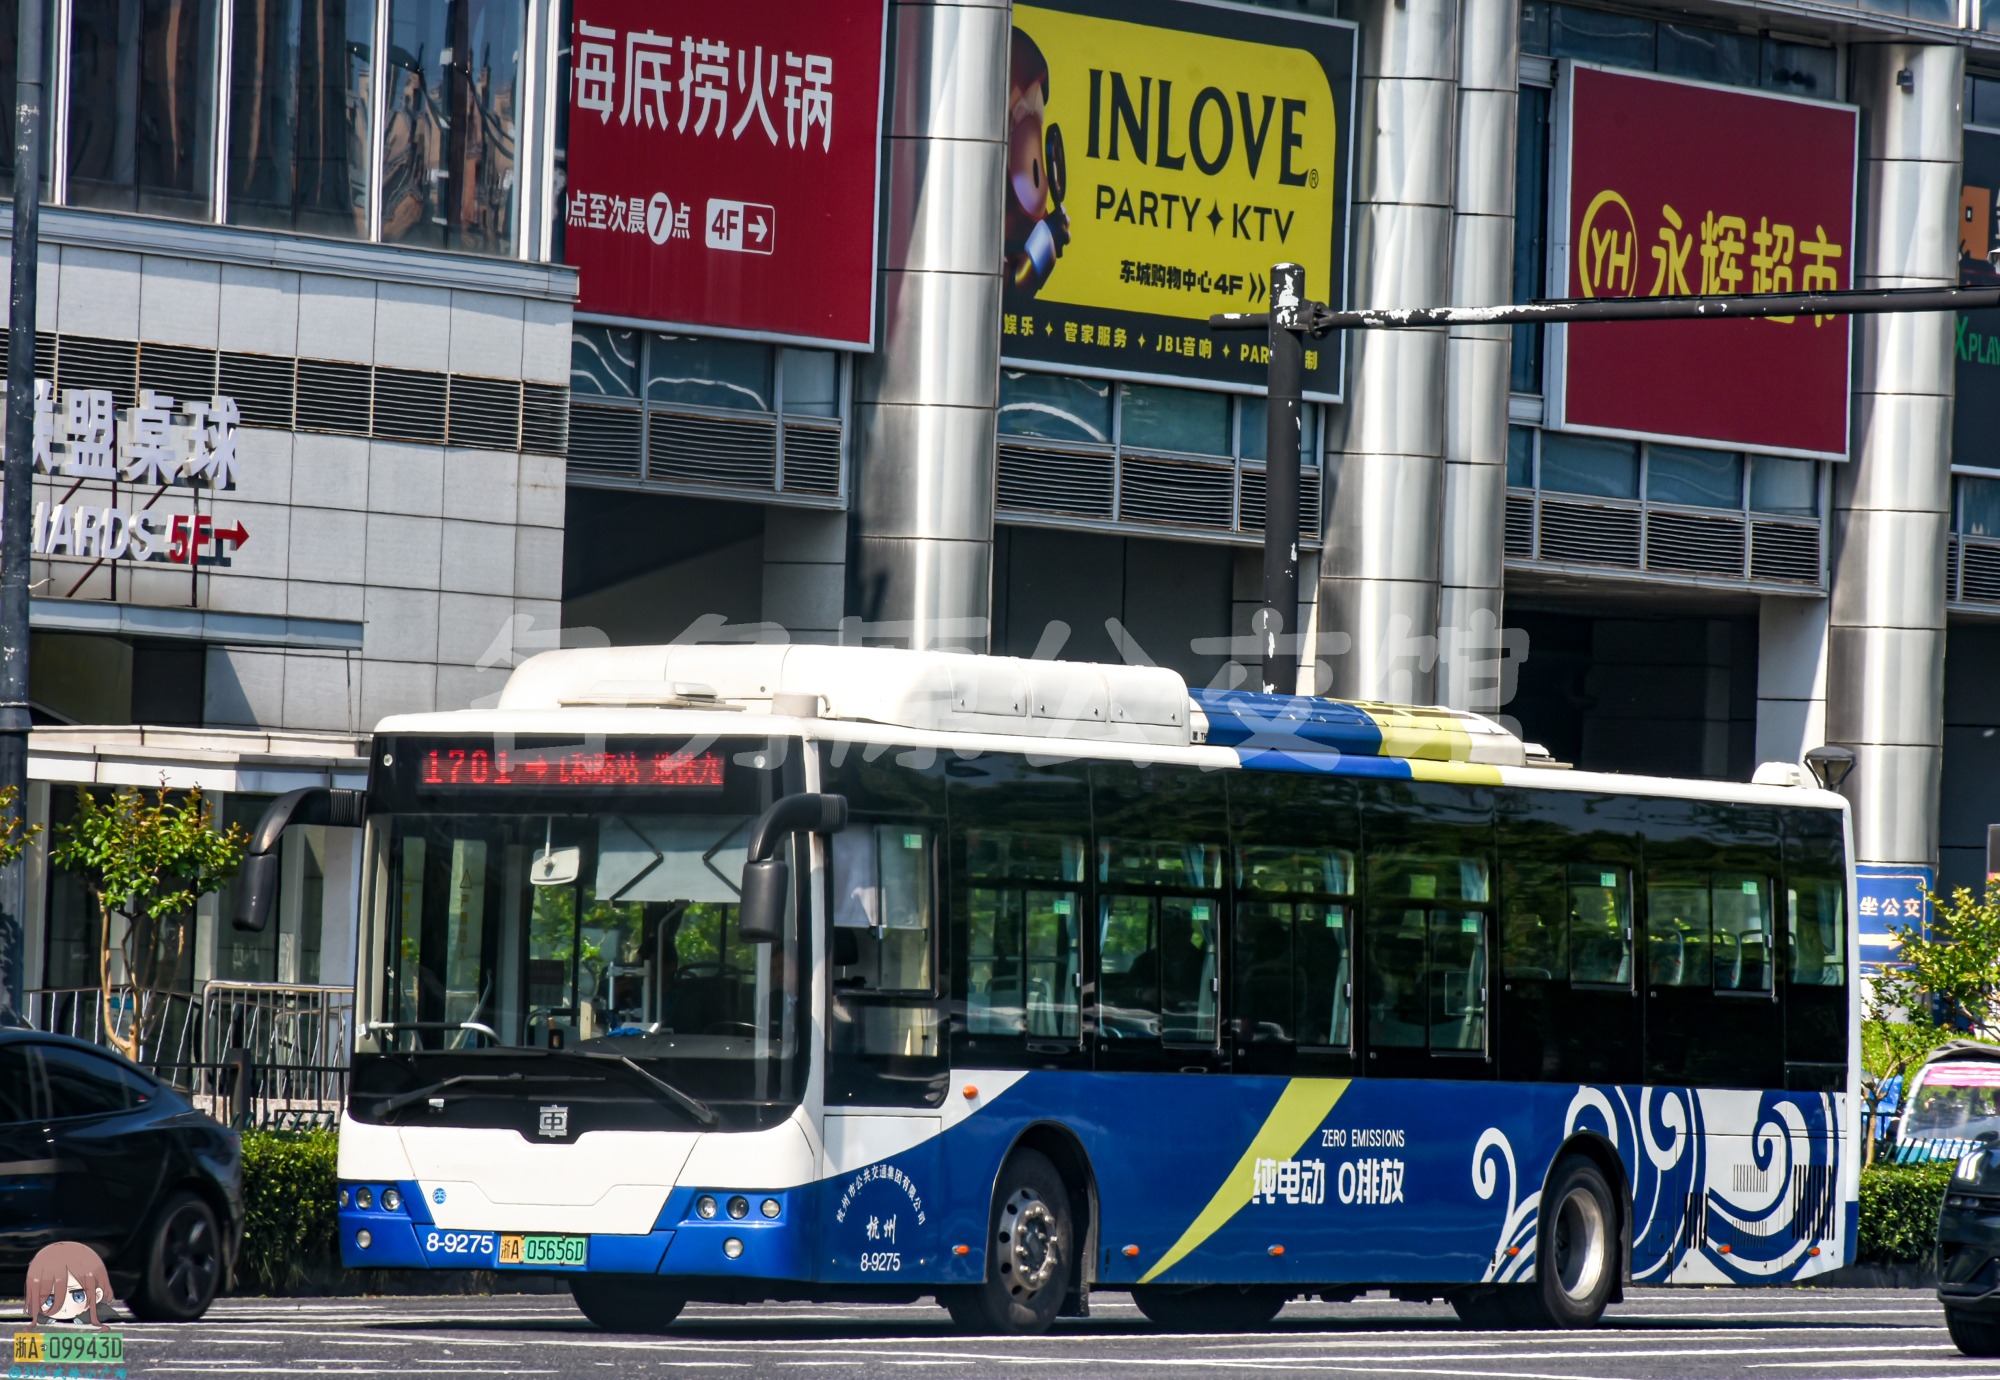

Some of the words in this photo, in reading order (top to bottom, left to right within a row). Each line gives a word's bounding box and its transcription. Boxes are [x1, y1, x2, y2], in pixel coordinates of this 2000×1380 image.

[571, 20, 833, 154] 海底捞火锅
[711, 208, 740, 241] 4F
[1095, 184, 1202, 232] PARTY
[1232, 203, 1295, 244] KTV
[1591, 228, 1632, 291] YH
[1650, 204, 1842, 328] 永辉超市
[1003, 313, 1034, 337] 娱乐
[1064, 321, 1127, 349] 管家服务
[1156, 334, 1212, 359] JBL音响
[424, 749, 512, 784] 1701
[1860, 896, 1921, 918] 坐公交
[1322, 1129, 1347, 1148] ZERO
[1351, 1129, 1405, 1148] EMISSIONS
[1252, 1157, 1325, 1204] 纯电动
[1338, 1158, 1405, 1204] 0排放
[426, 1232, 493, 1254] 8-9275
[866, 1213, 897, 1244] 杭州
[860, 1252, 900, 1272] 8-9275
